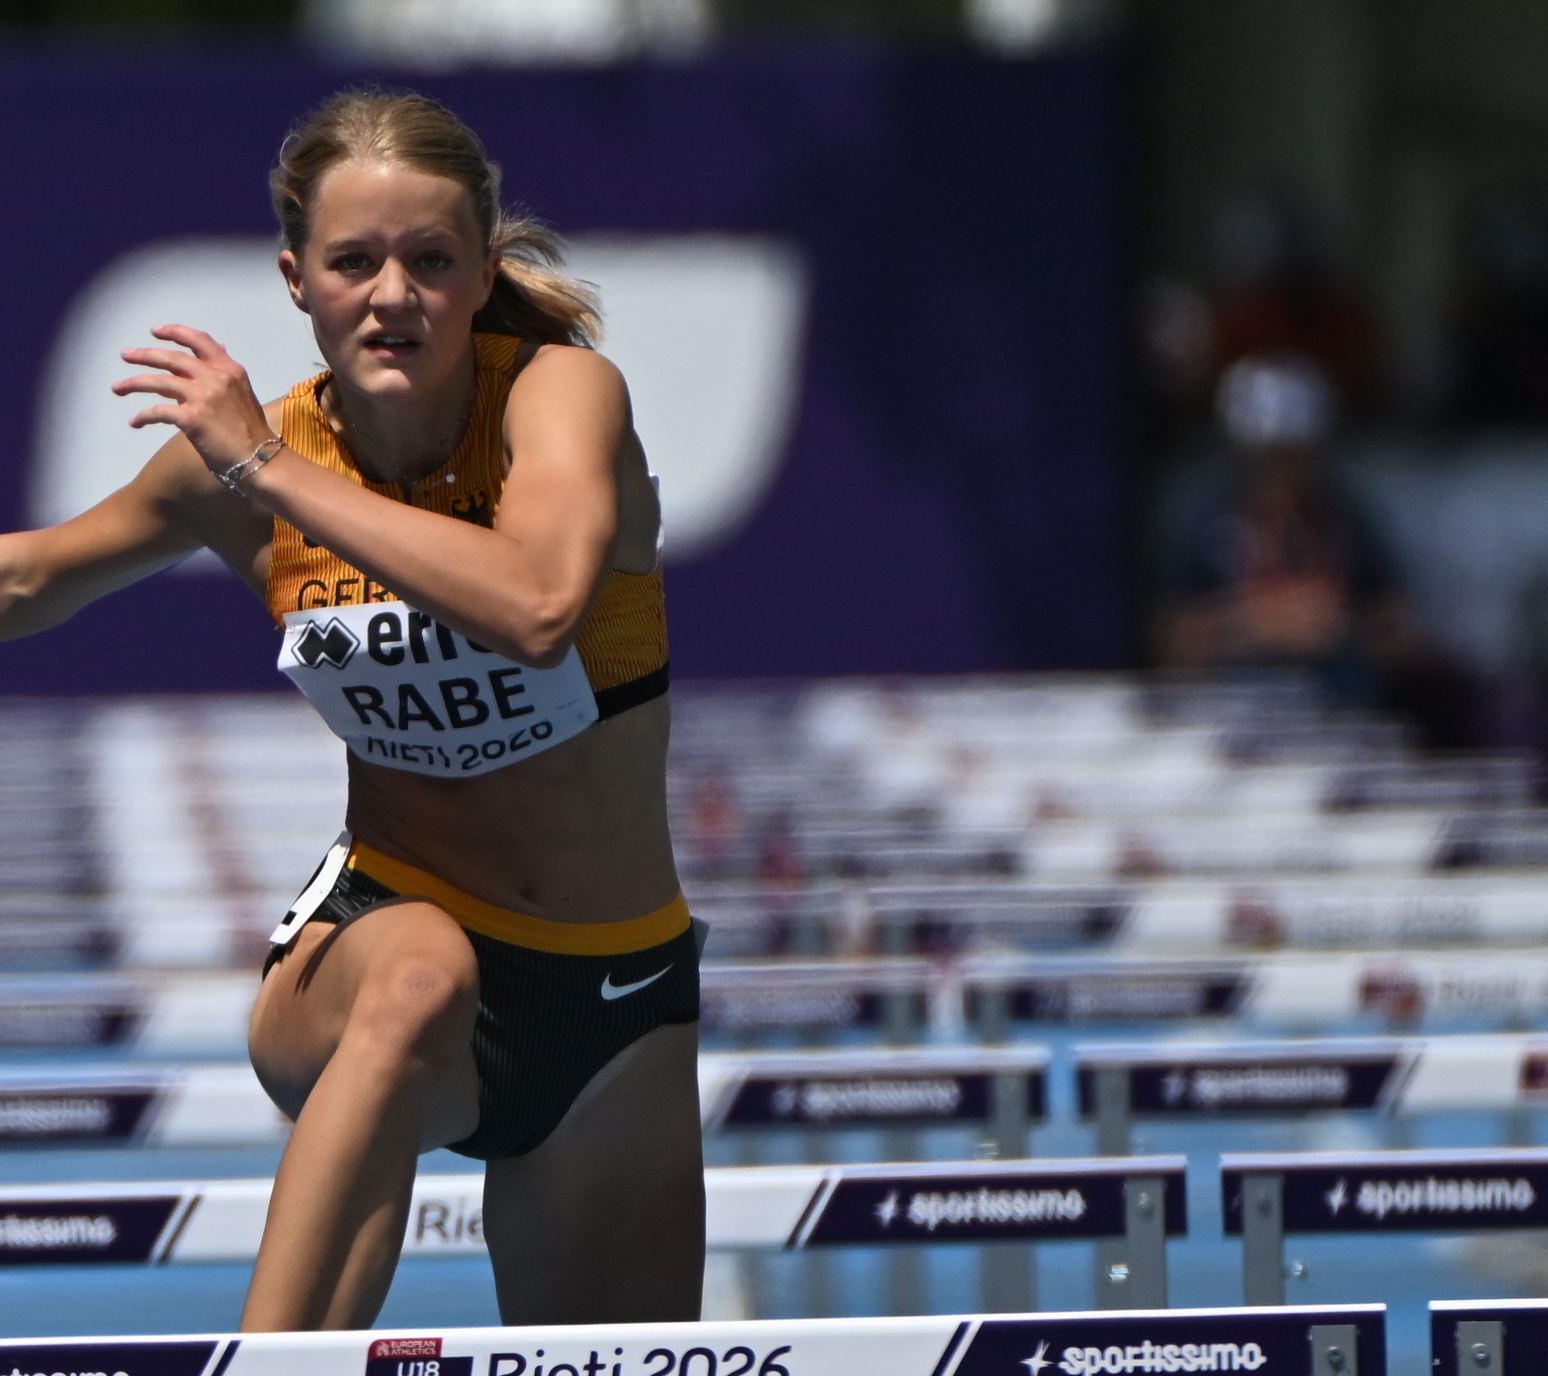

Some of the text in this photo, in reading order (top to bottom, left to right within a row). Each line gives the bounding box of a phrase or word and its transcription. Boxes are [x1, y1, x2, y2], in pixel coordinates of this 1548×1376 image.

[341, 667, 536, 731] RABE
[907, 1185, 1088, 1231] sportissimo
[1356, 1175, 1536, 1216] sportissimo
[391, 1341, 436, 1349] EUROPEAN
